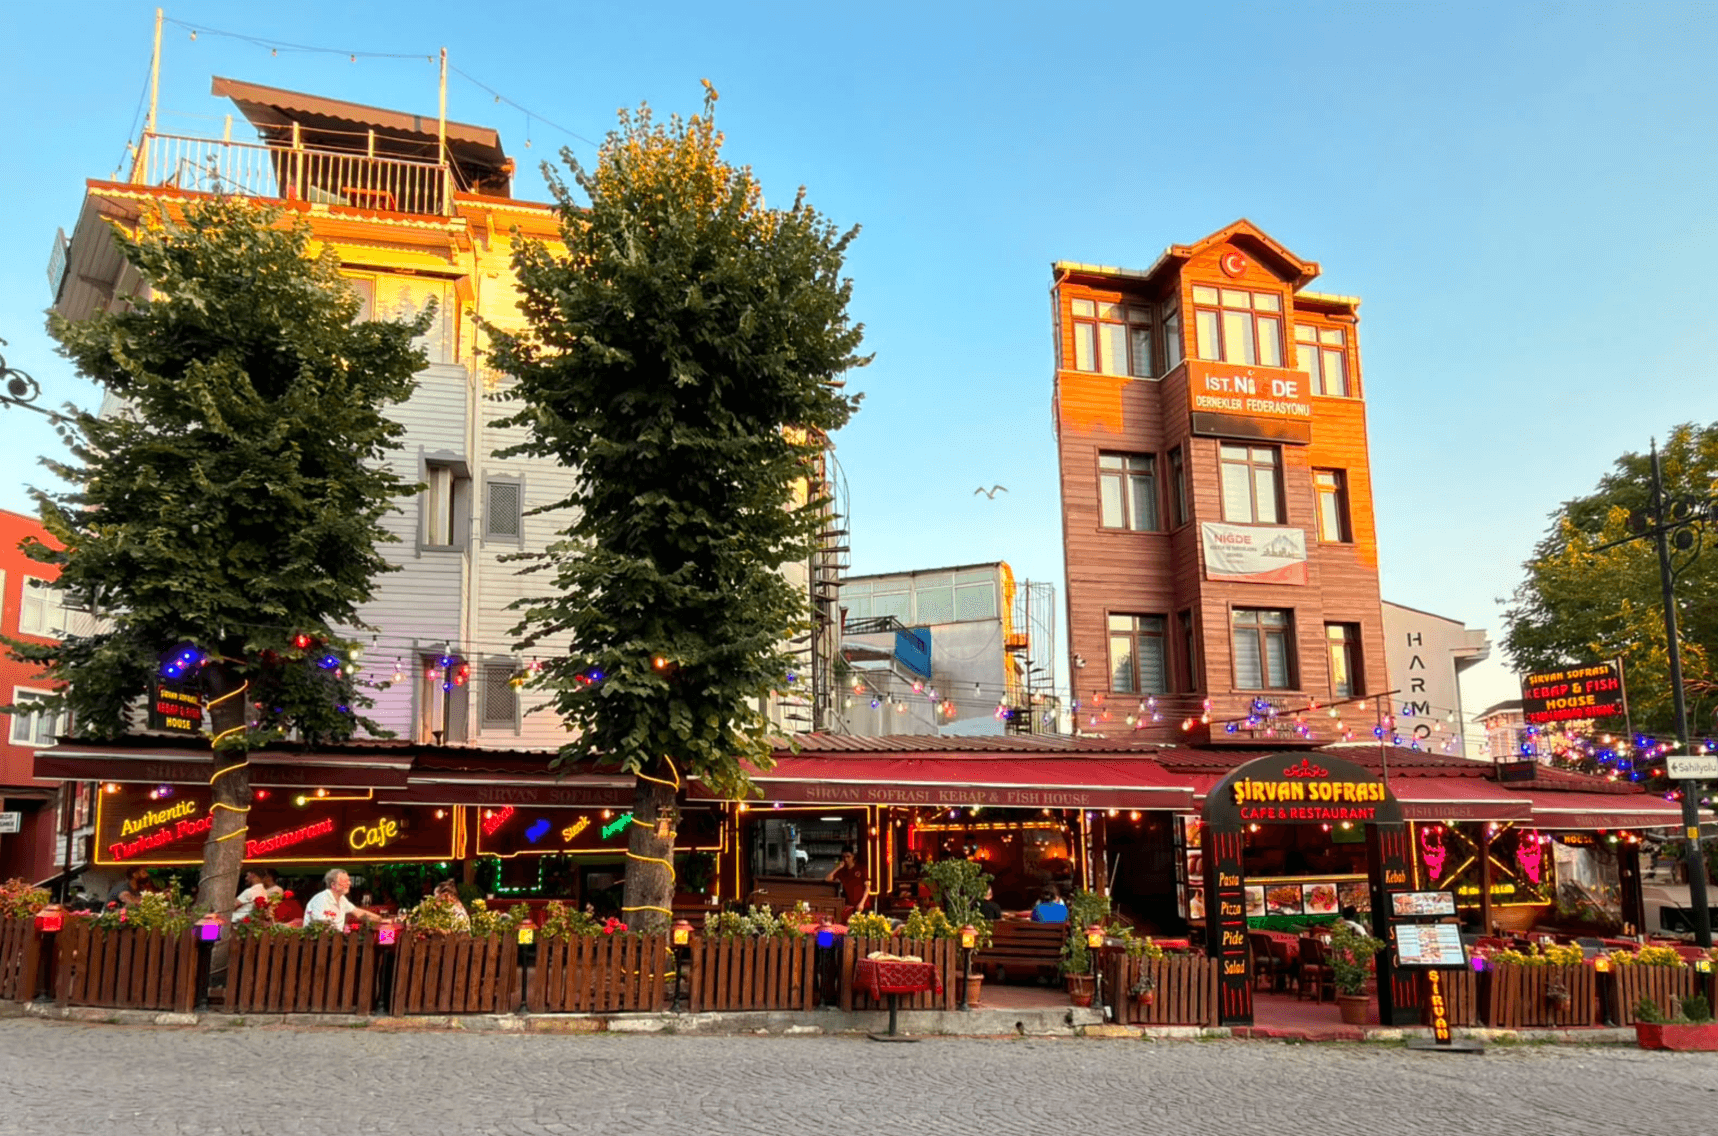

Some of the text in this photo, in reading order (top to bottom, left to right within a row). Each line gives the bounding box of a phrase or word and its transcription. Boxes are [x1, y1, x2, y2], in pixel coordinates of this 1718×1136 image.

[1196, 395, 1310, 416] DERNEKLER FEDERASYONU
[1566, 665, 1609, 679] SOFRASI
[1407, 632, 1431, 752] HARMO
[1524, 678, 1619, 699] KEBAP & FISH
[1545, 694, 1596, 710] HOUSE
[166, 716, 191, 730] HOUSE
[1678, 762, 1717, 774] Sahilyolu
[868, 789, 930, 801] SOFRASI
[939, 790, 986, 801] KEBAP
[989, 791, 998, 802] &
[1043, 792, 1090, 805] HOUSE
[1308, 782, 1385, 802] SOFRASI
[120, 800, 196, 837] Authentic
[1240, 807, 1375, 819] CAFE & RESTAURANT
[245, 818, 333, 858] Restaurant
[350, 817, 398, 849] Cafe
[1219, 871, 1240, 887] Pasta
[1221, 901, 1241, 916] Pizza
[1222, 930, 1244, 946] Pide
[1224, 960, 1245, 975] Salad
